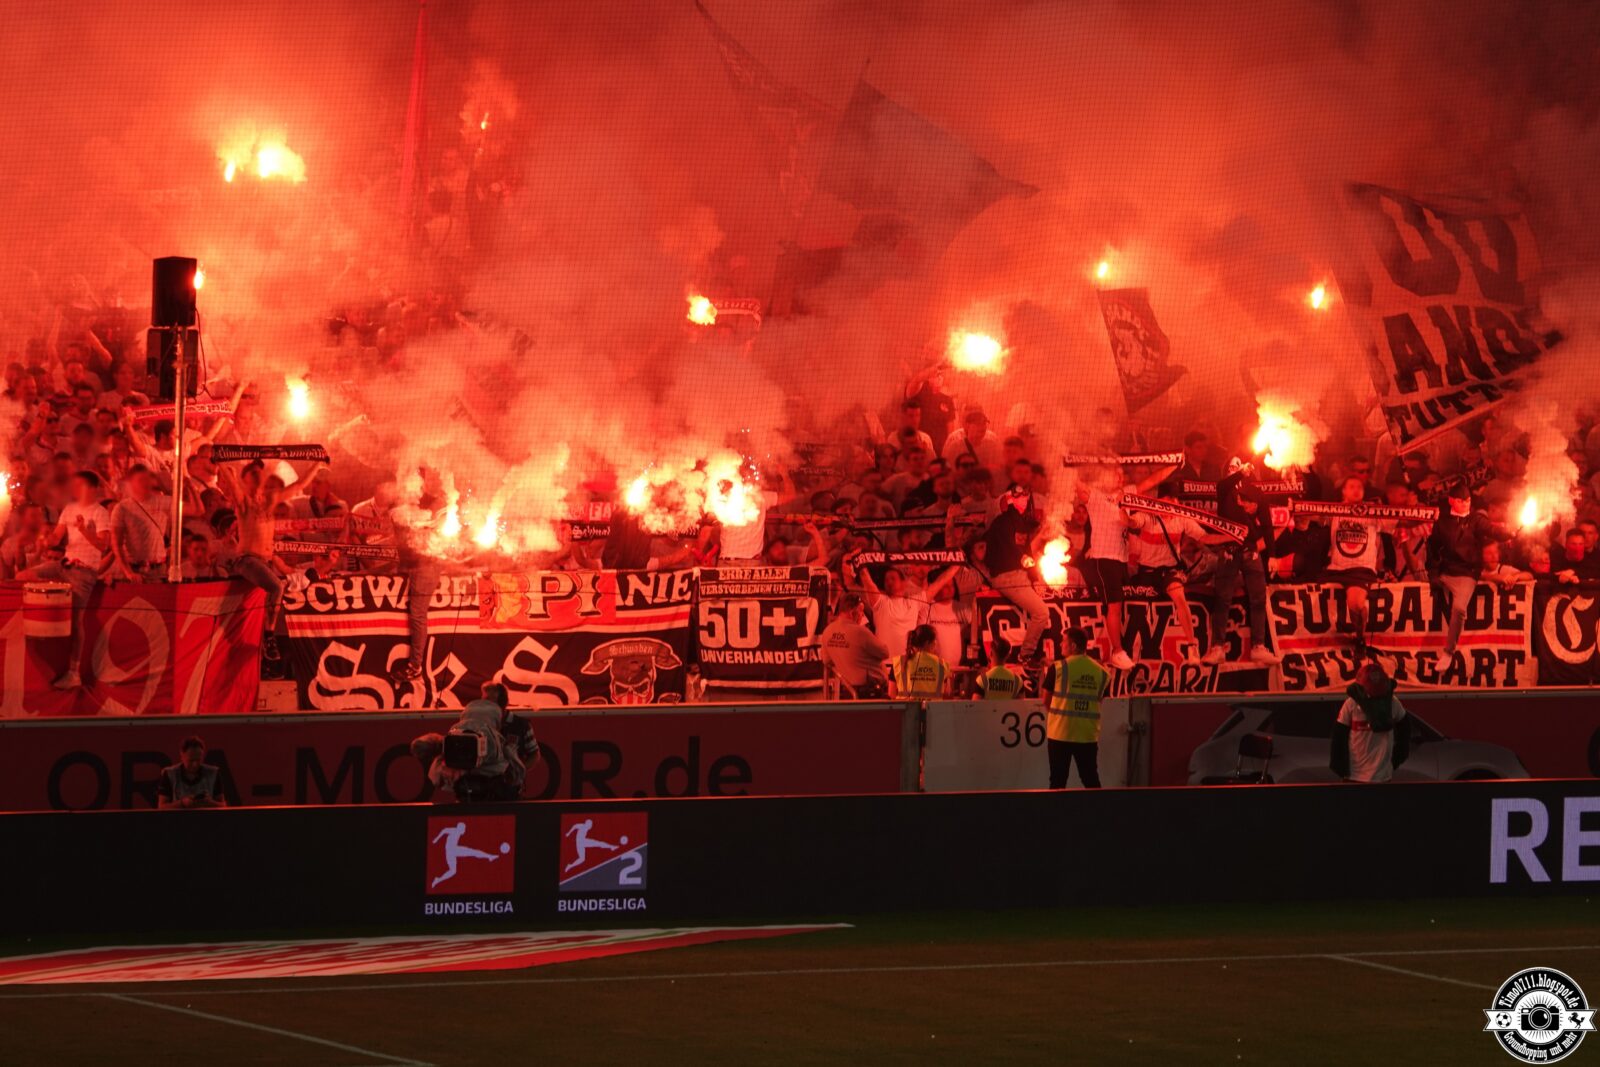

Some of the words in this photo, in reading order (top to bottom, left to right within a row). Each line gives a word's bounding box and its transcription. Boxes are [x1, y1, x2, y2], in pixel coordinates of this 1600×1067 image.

[1368, 506, 1434, 519] STUTTGART
[854, 552, 886, 568] CREW
[718, 568, 751, 581] EHRE
[752, 566, 790, 580] ALLEN
[700, 584, 771, 595] VERSTORBENEN
[772, 582, 808, 595] ULTRAS
[699, 598, 819, 649] 50+1
[1283, 650, 1525, 690] STUTGART
[988, 677, 1016, 692] SECURITY
[1000, 712, 1046, 748] 36
[1490, 796, 1600, 884] RE
[618, 851, 643, 885] 2
[424, 901, 514, 915] BUNDESLIGA
[557, 897, 647, 912] BUNDESLIGA
